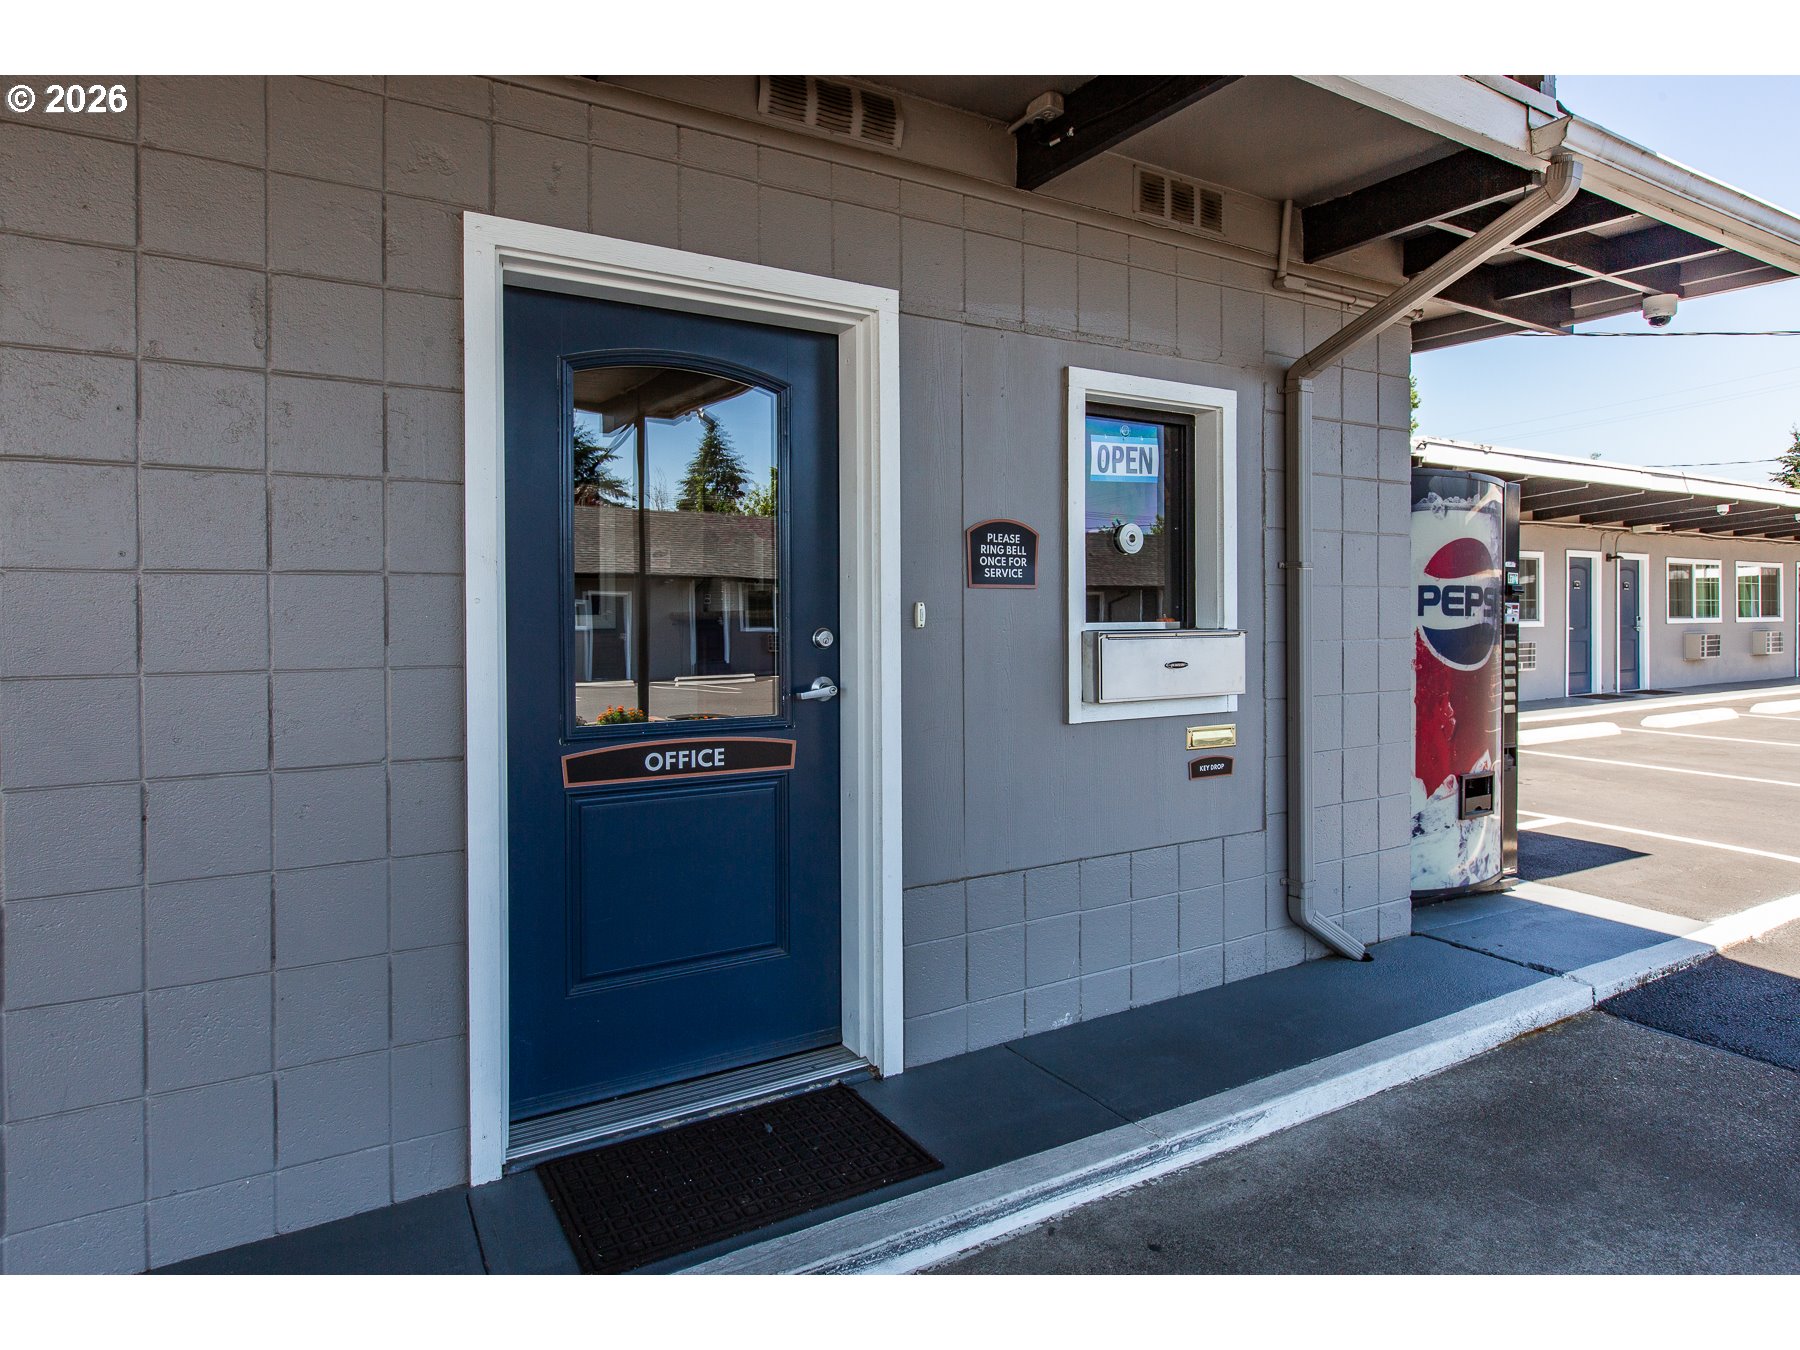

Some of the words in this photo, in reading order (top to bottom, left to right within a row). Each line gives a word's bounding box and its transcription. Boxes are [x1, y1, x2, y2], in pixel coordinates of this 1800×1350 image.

[1097, 444, 1153, 475] OPEN
[987, 533, 1020, 543] PLEASE
[980, 545, 1004, 555] RING
[1006, 546, 1026, 555] BELL
[980, 556, 1006, 566] ONCE
[1008, 557, 1027, 567] FOR
[984, 568, 1023, 578] SERVICE
[645, 748, 725, 772] OFFICE
[1199, 764, 1210, 772] KEY
[1210, 763, 1225, 771] DROP
